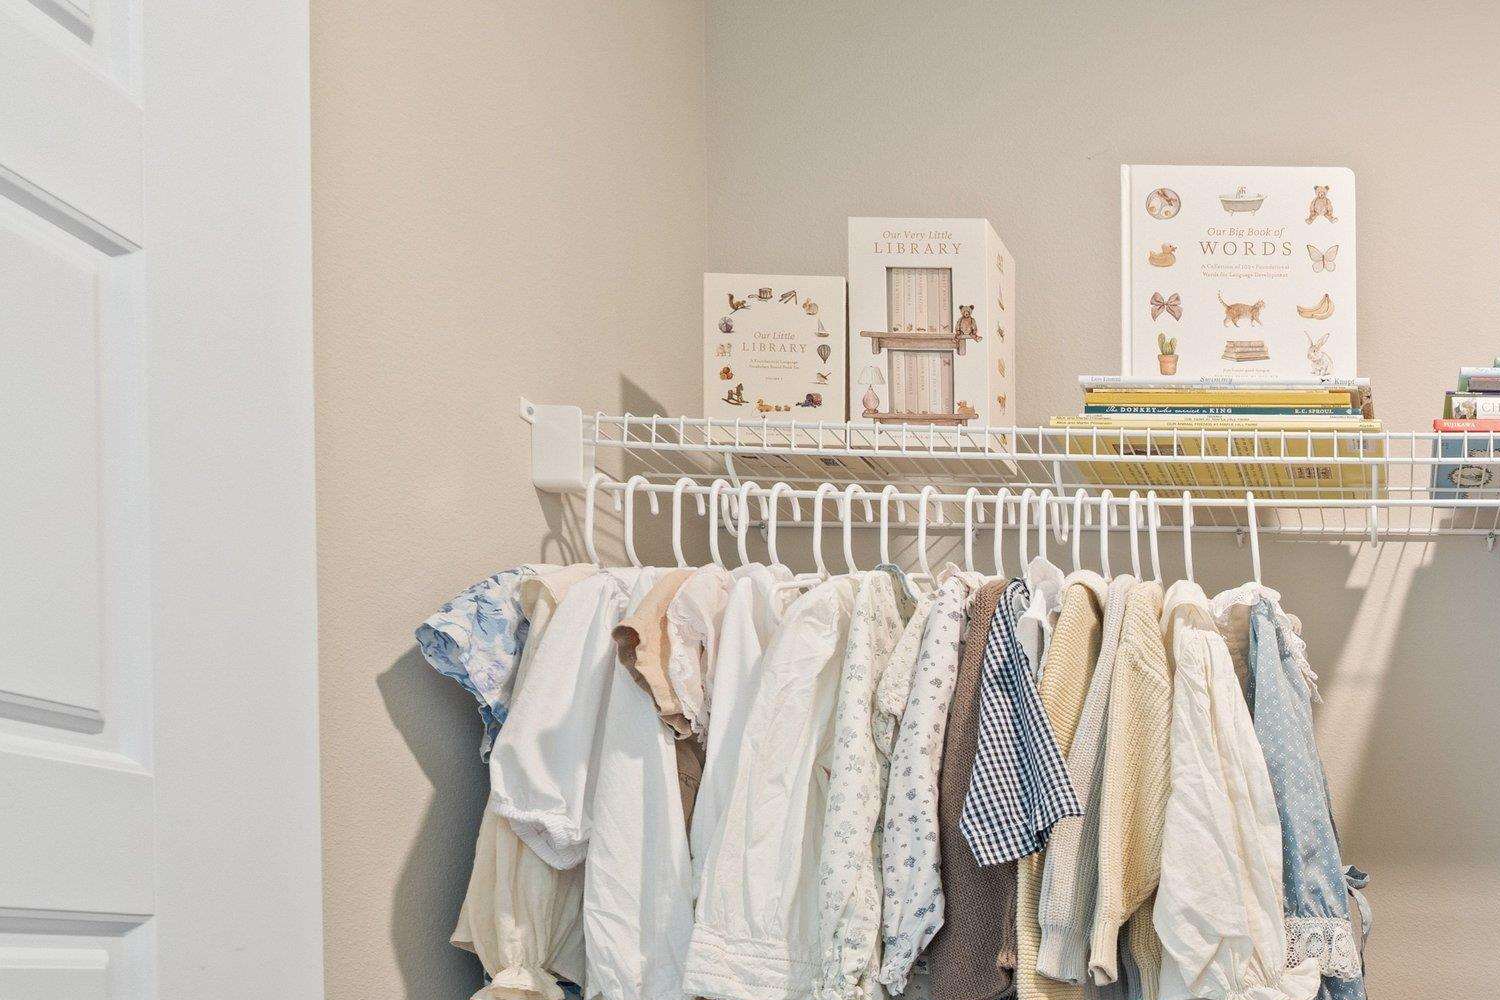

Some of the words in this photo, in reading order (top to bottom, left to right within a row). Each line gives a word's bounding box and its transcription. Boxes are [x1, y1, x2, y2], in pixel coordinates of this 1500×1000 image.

[882, 230, 900, 239] Our
[904, 230, 926, 240] Very
[928, 230, 953, 240] Little
[1207, 227, 1227, 237] Our
[1229, 227, 1245, 238] Big
[1248, 227, 1271, 237] Book
[1273, 227, 1285, 239] of
[873, 242, 962, 255] LIBRARY
[1198, 241, 1292, 256] WORDS
[753, 331, 770, 340] Our
[772, 331, 796, 340] Little
[741, 342, 807, 353] LIBRARY
